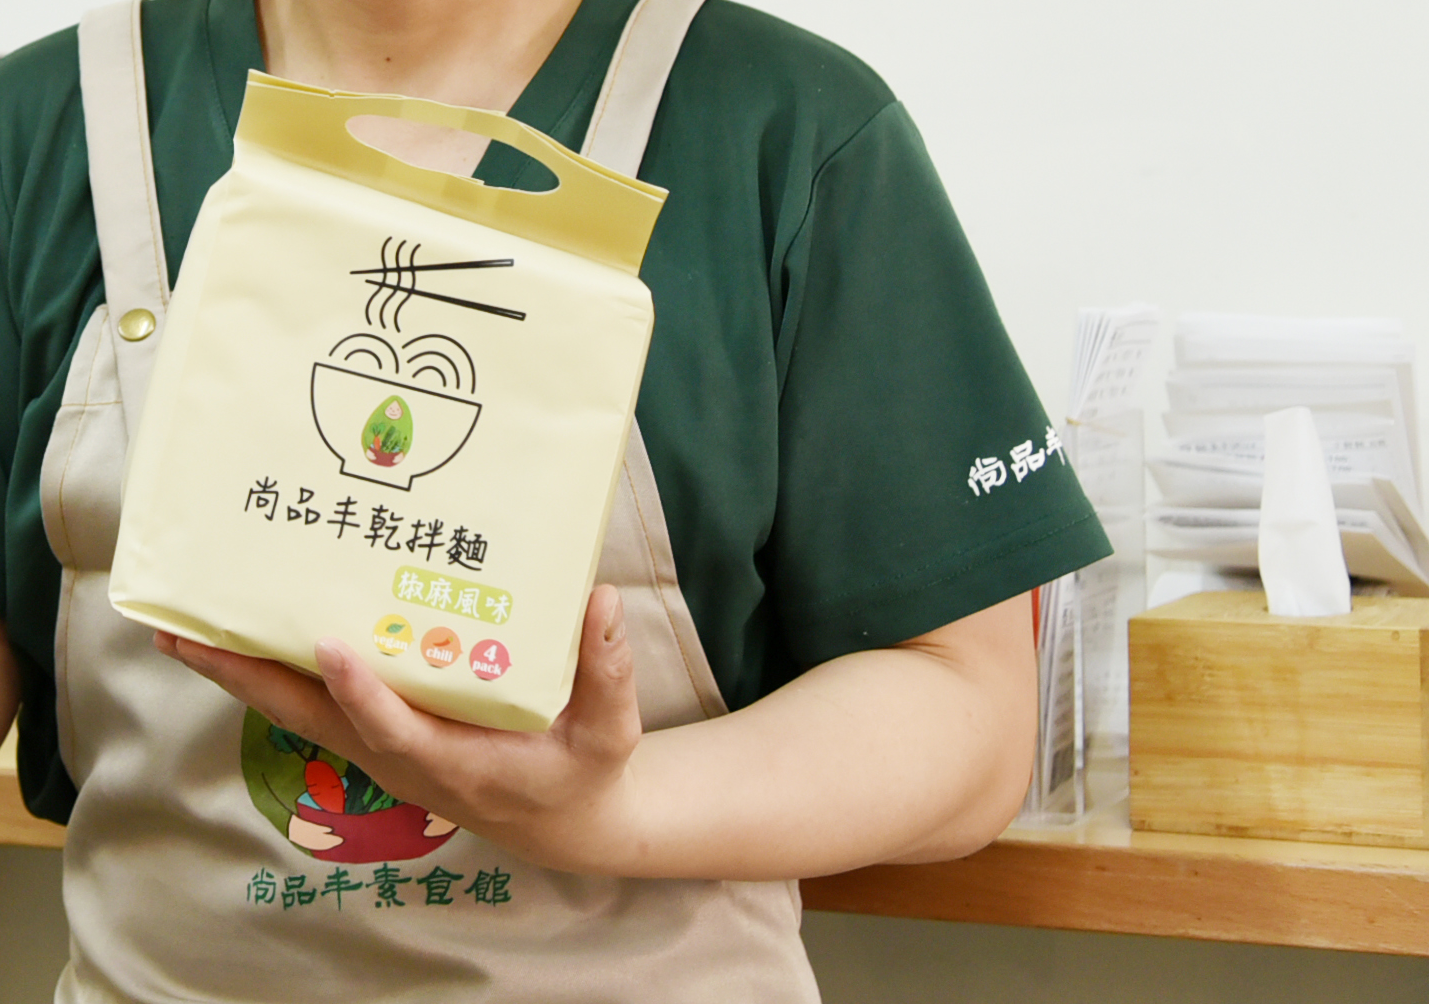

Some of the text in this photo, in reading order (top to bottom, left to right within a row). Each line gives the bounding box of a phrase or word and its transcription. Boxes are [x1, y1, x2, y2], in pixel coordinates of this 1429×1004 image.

[244, 476, 489, 571] 尚品丰乾拌麵
[397, 570, 511, 624] 椒麻風味
[373, 633, 409, 652] vegan
[425, 647, 454, 663] chili
[483, 644, 499, 662] 4
[472, 660, 503, 676] pack
[246, 862, 513, 912] 尚品丰素食館
